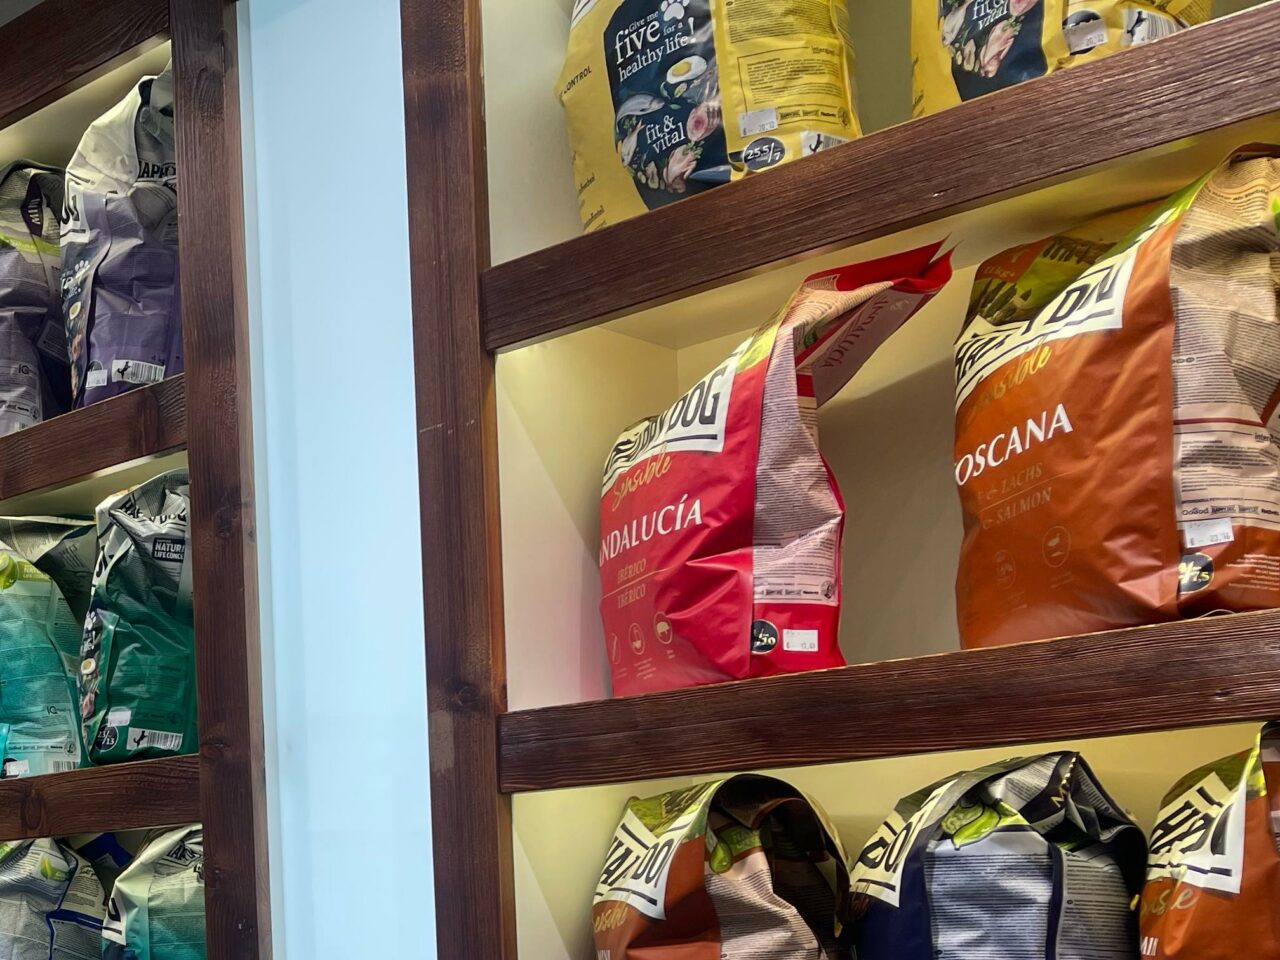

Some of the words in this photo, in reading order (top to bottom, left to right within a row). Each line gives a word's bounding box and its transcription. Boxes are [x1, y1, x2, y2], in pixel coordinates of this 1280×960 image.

[628, 17, 646, 32] Give
[645, 10, 659, 22] me
[663, 24, 676, 36] for
[977, 3, 1009, 30] vital
[614, 20, 661, 65] five
[618, 45, 665, 83] healthy
[564, 65, 592, 94] ONTROL
[646, 122, 662, 145] fit
[663, 114, 676, 132] &
[652, 122, 687, 155] vital
[955, 403, 1073, 486] OSCANA
[166, 552, 184, 560] CONCE
